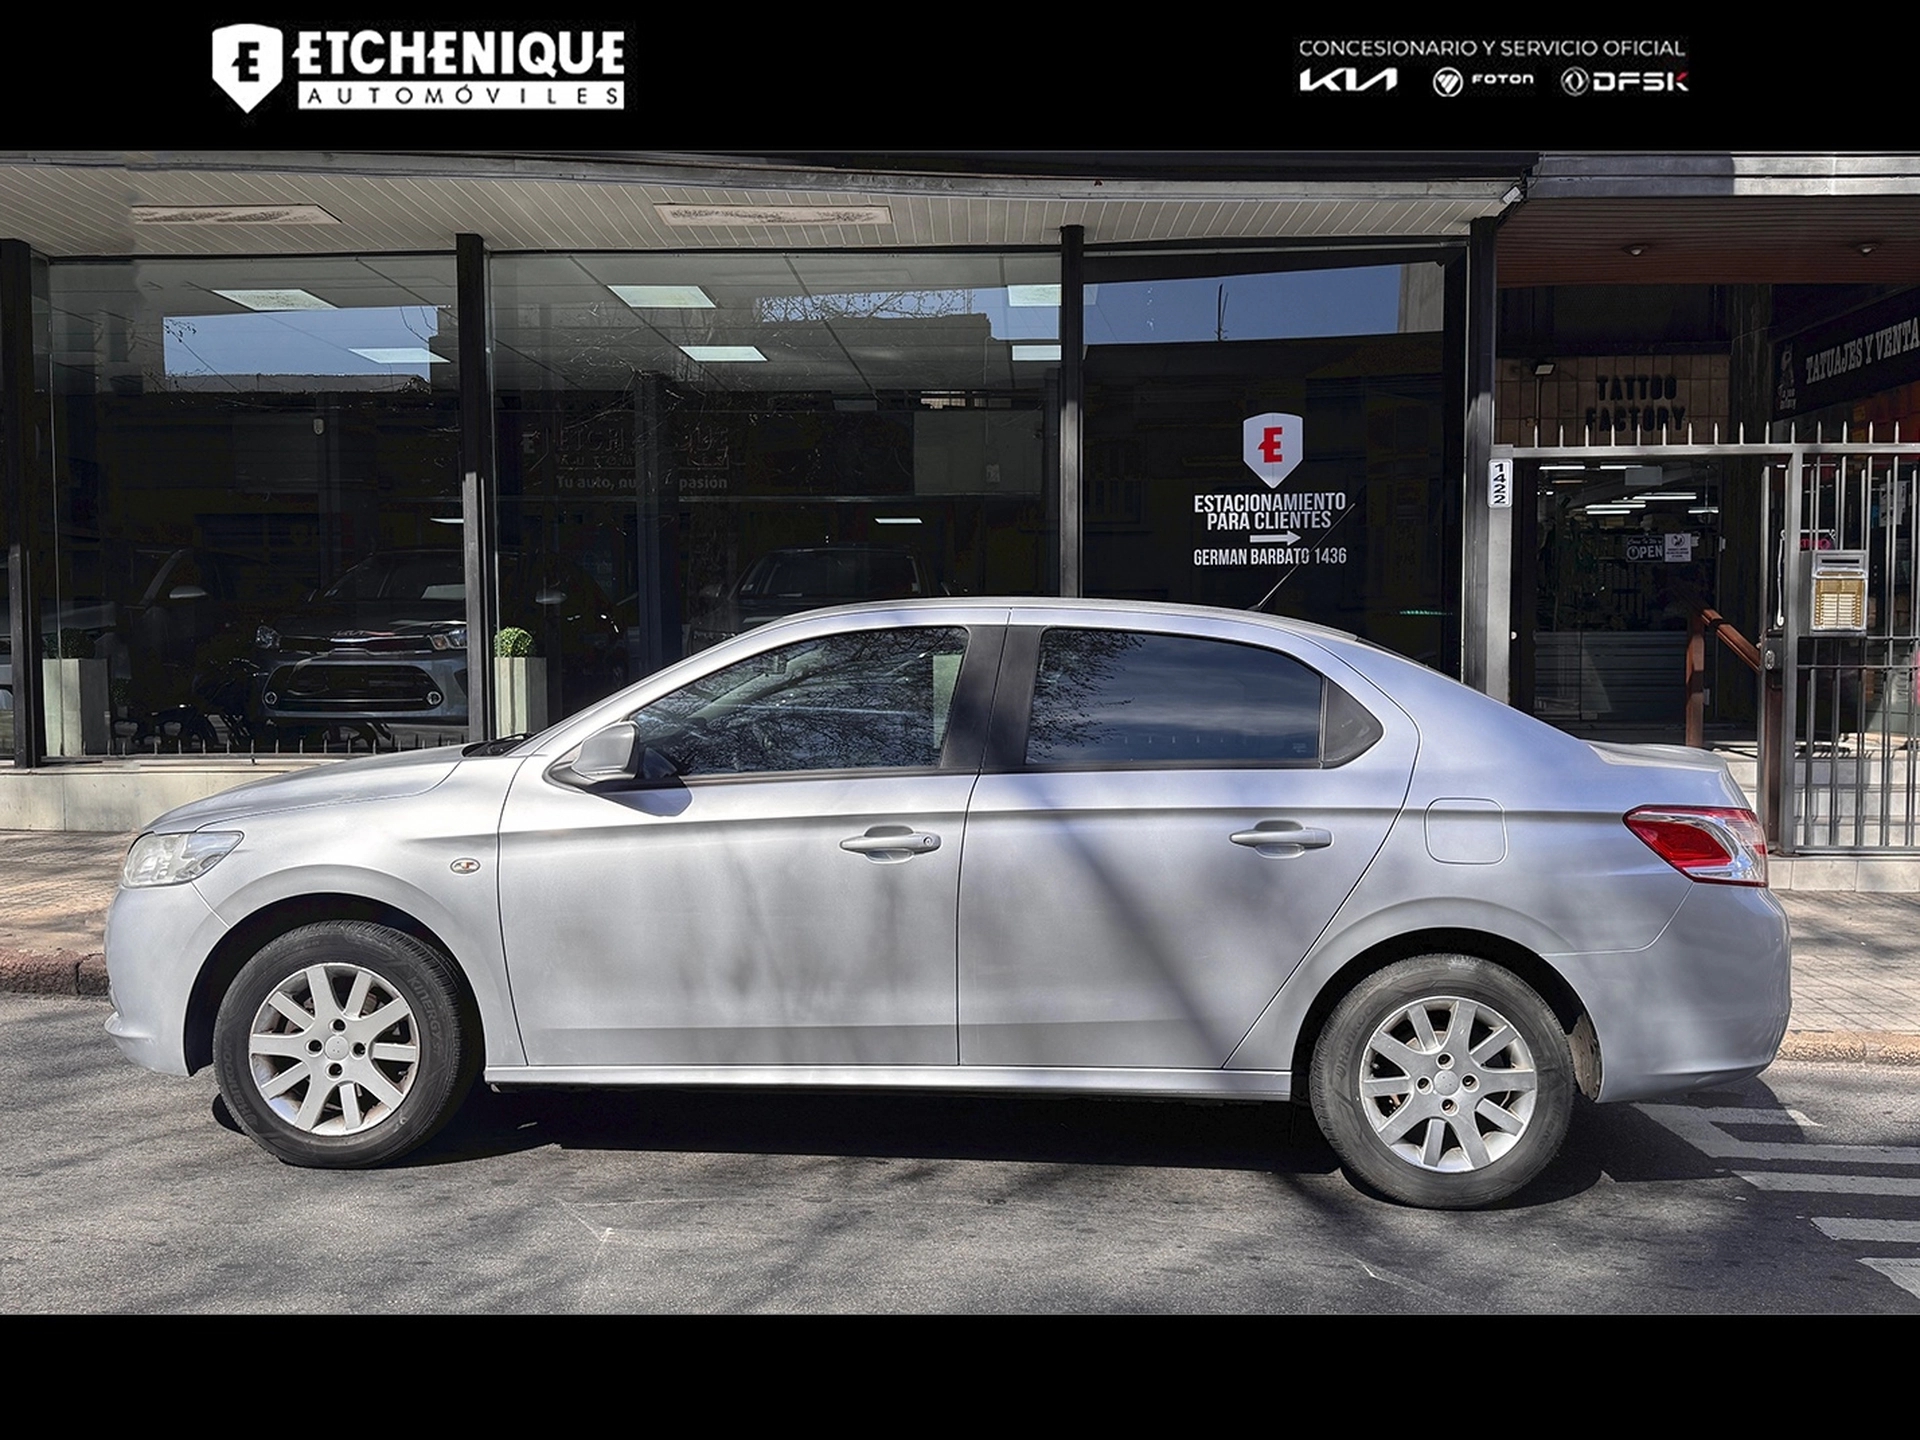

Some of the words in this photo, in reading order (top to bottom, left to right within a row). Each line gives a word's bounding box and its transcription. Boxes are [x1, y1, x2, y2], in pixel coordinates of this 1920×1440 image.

[1805, 337, 1863, 385] TATUAJES
[1864, 333, 1875, 365] Y
[1597, 375, 1677, 400] TATTOO
[1586, 406, 1686, 431] FACTORY
[1493, 463, 1506, 504] 1422
[1194, 492, 1346, 513] ESTACIONAMIENTO
[1207, 513, 1250, 530] PARA
[1254, 511, 1331, 529] CLIENTES
[1194, 549, 1247, 565] GERMAN
[1250, 548, 1309, 564] BARBATO
[1314, 547, 1347, 564] 1436
[1626, 545, 1663, 560] OPEN
